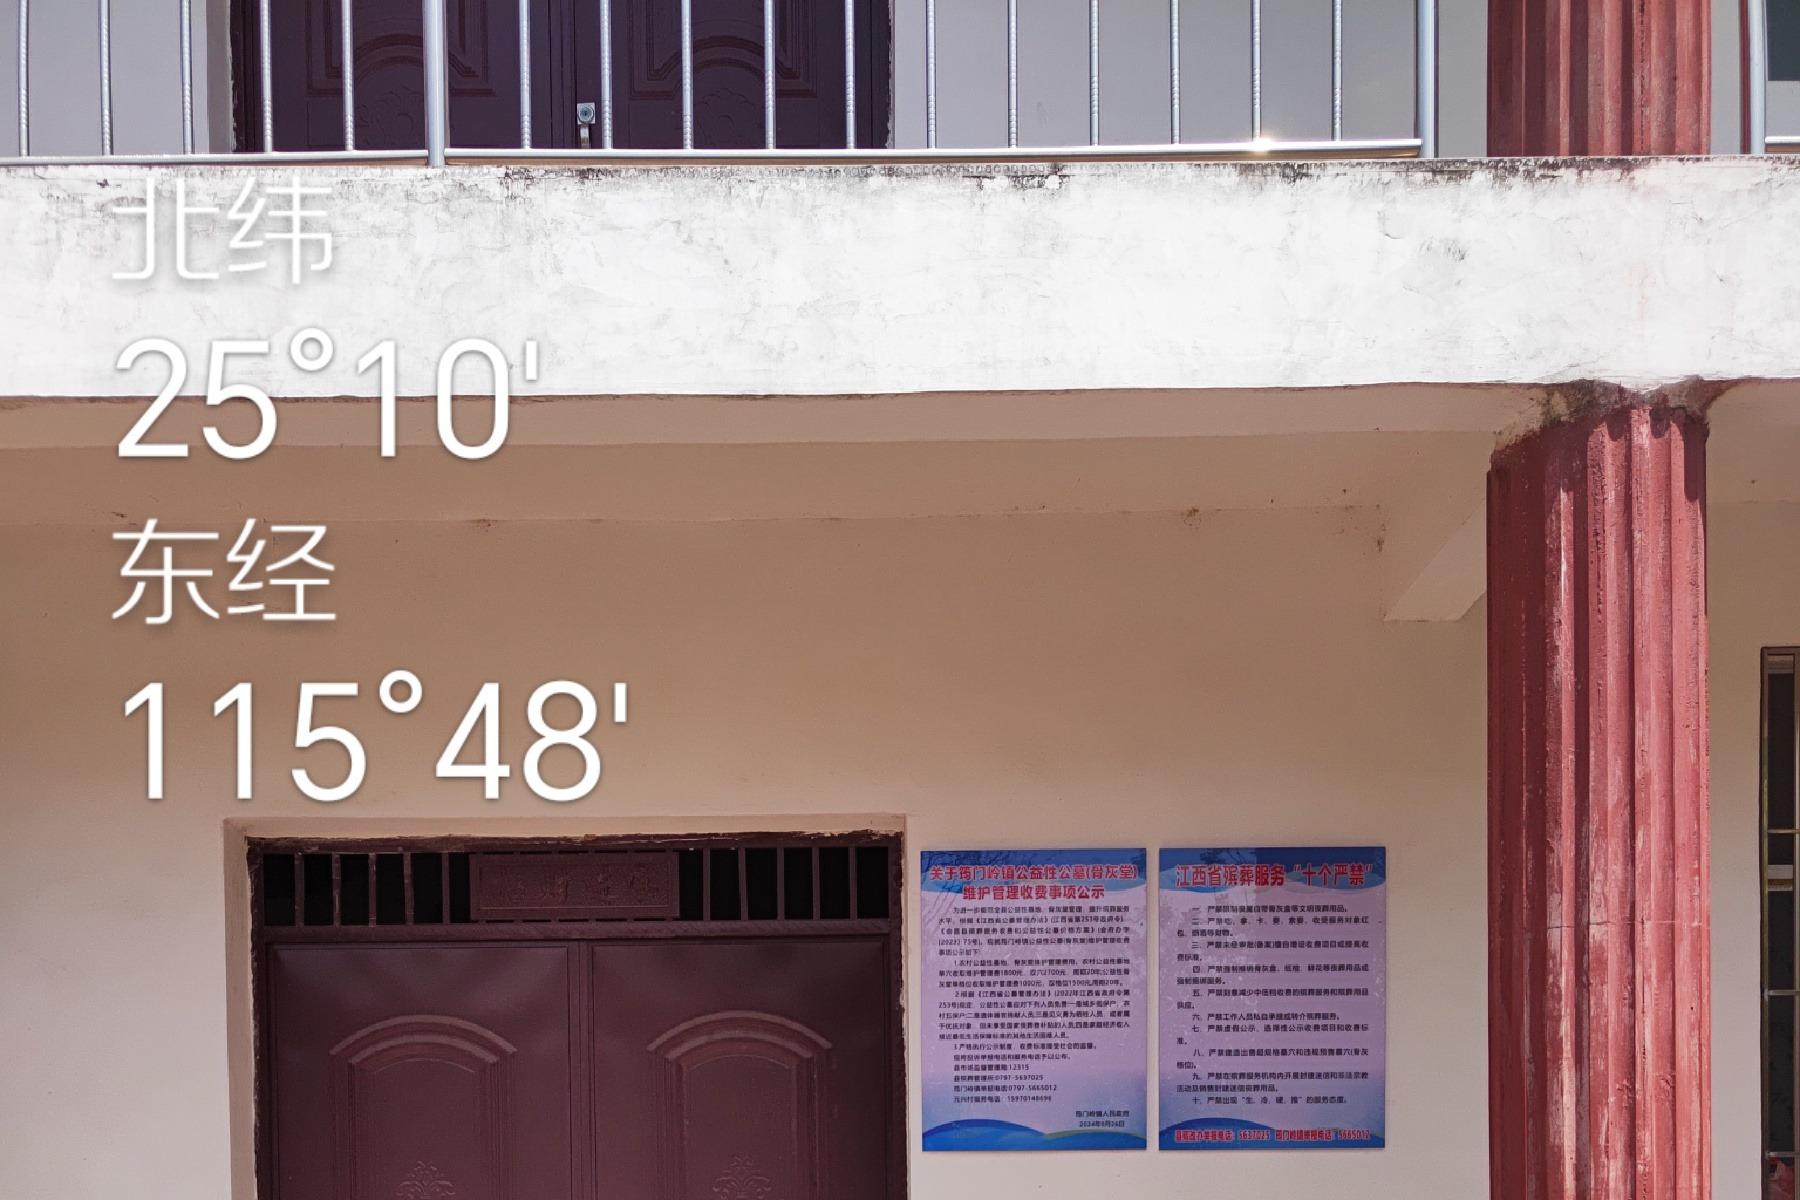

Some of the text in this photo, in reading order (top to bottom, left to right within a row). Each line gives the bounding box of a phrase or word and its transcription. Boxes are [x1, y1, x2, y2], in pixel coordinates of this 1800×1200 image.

[962, 885, 1105, 900] 维护管理收费事项公示
